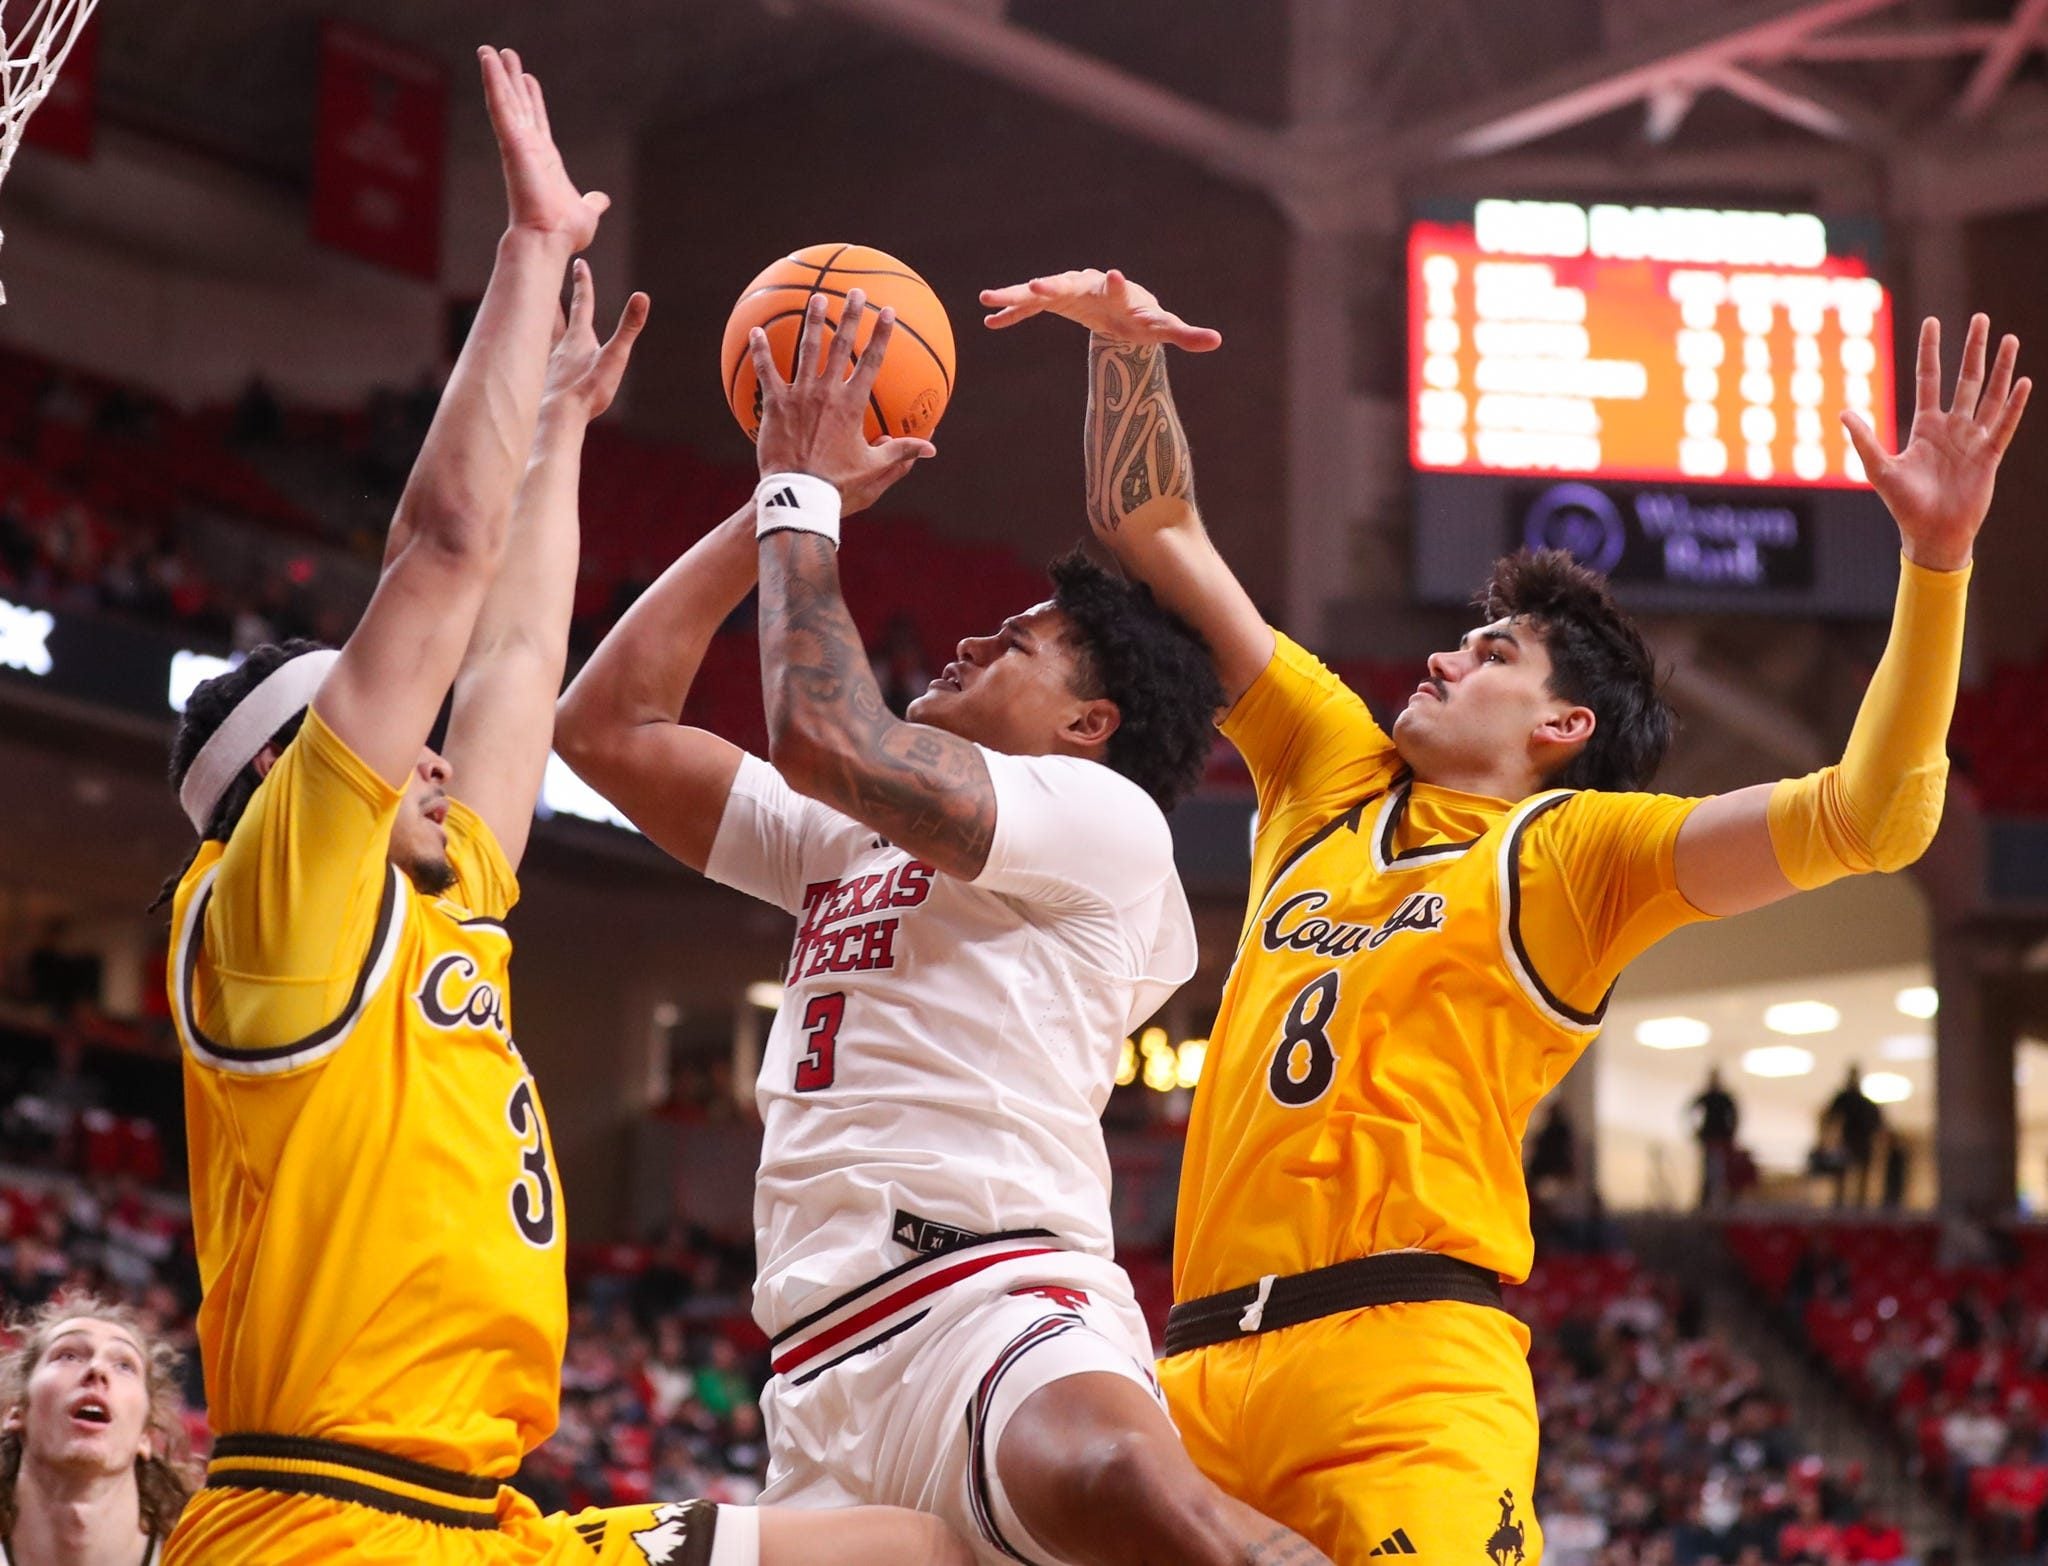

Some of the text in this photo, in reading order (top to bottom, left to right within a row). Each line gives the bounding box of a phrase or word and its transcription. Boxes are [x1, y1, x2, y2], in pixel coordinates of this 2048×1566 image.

[797, 860, 936, 938] TEXAS
[787, 917, 900, 988] TECH
[794, 991, 846, 1093] 3
[1268, 969, 1340, 1108] 8
[508, 1080, 555, 1248] 3
